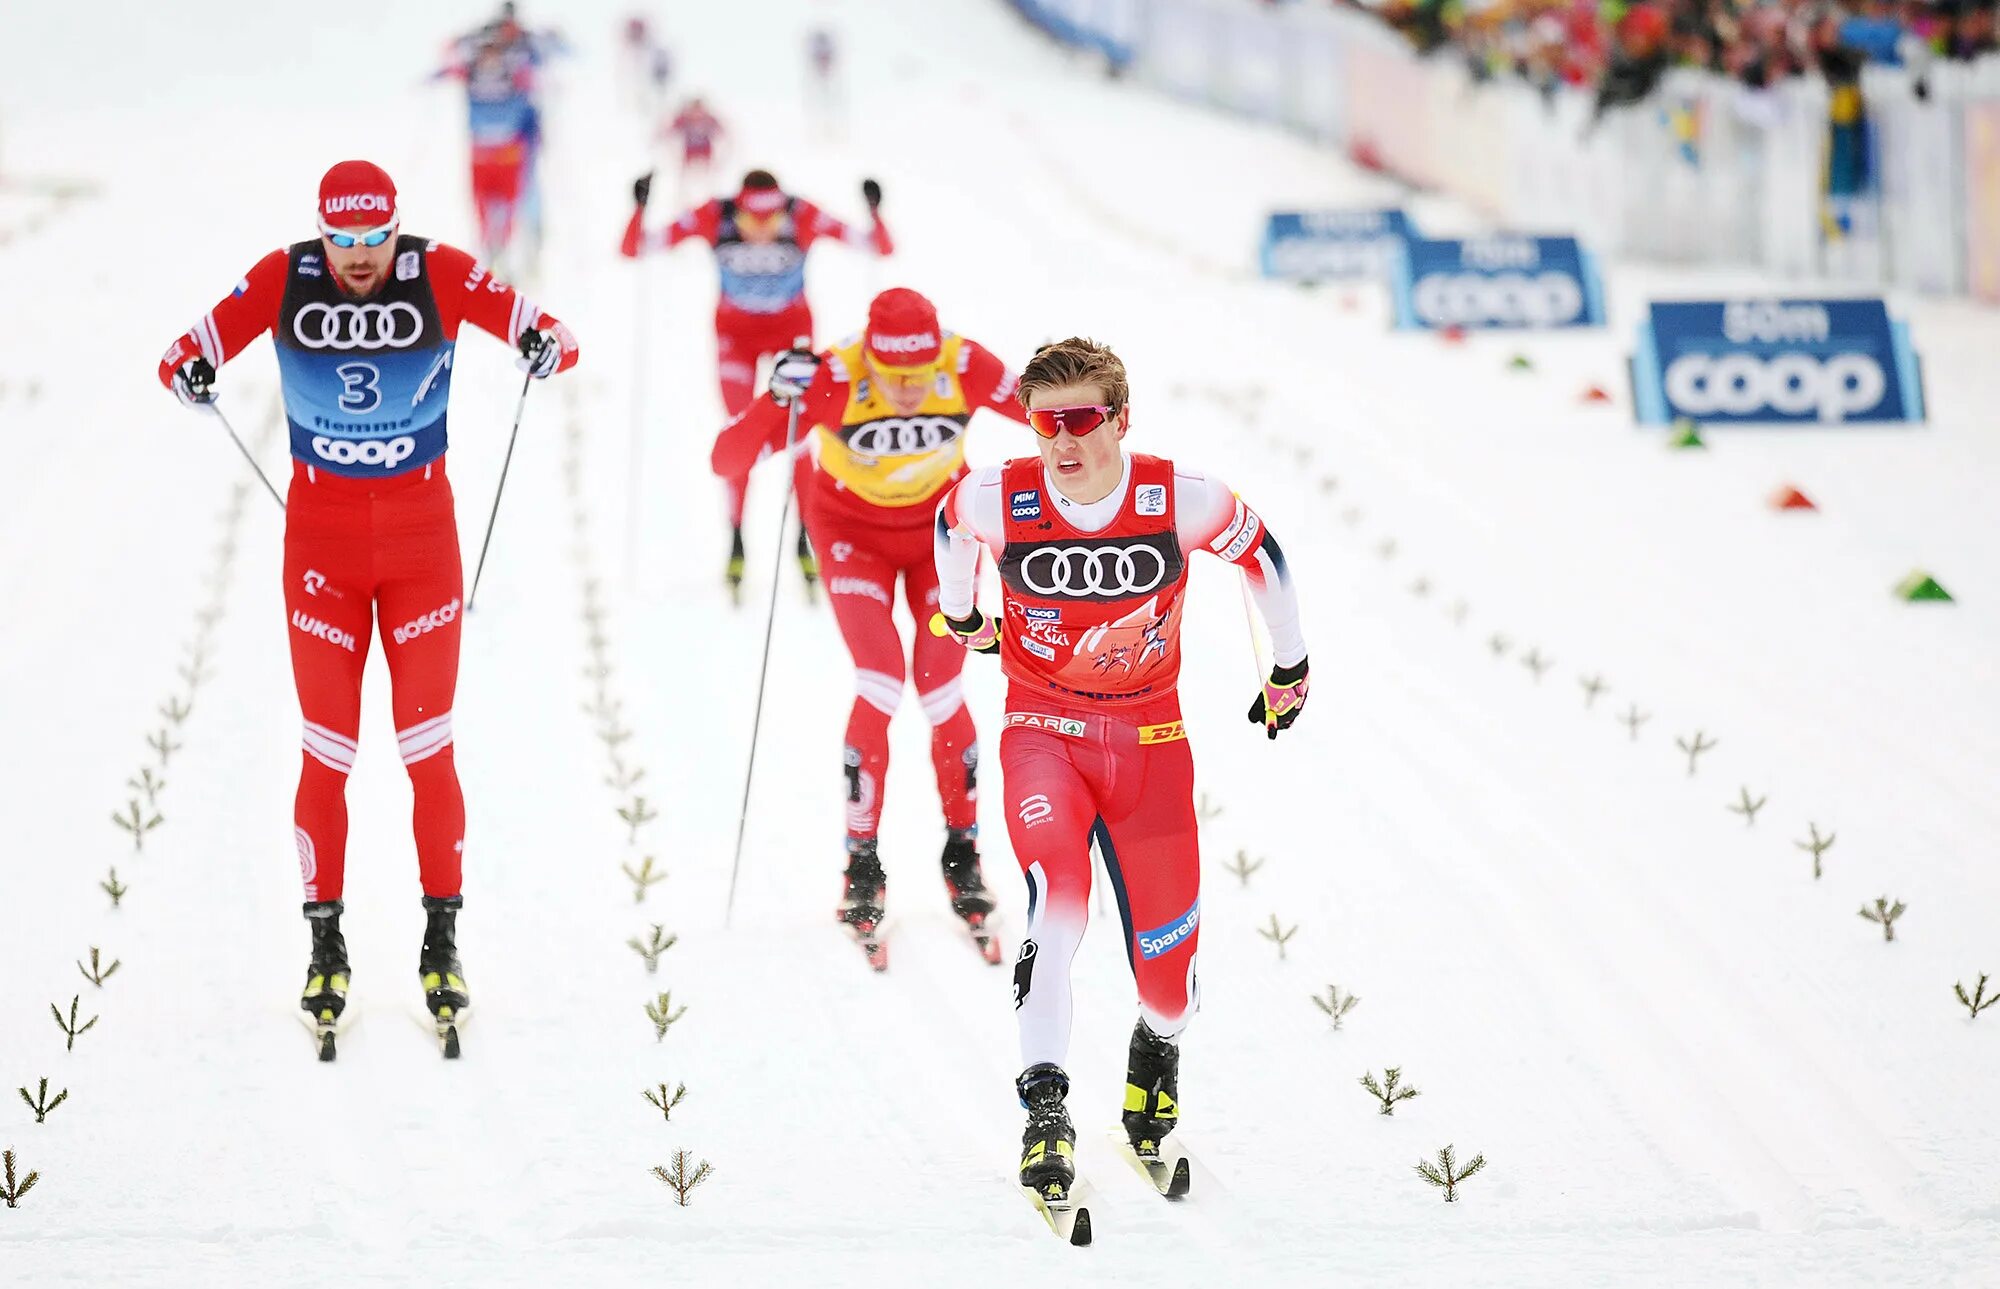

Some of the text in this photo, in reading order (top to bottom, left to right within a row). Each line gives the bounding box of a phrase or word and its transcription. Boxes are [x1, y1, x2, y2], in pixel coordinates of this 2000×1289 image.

[325, 193, 390, 214] LUKOIL
[336, 361, 382, 415] 3
[1665, 353, 1887, 424] coop
[311, 435, 416, 469] coop
[1011, 506, 1040, 517] coop
[292, 609, 356, 653] LUKOIL
[392, 602, 457, 645] BOSCO
[1027, 608, 1056, 619] coop
[1140, 910, 1200, 954] SpareB
